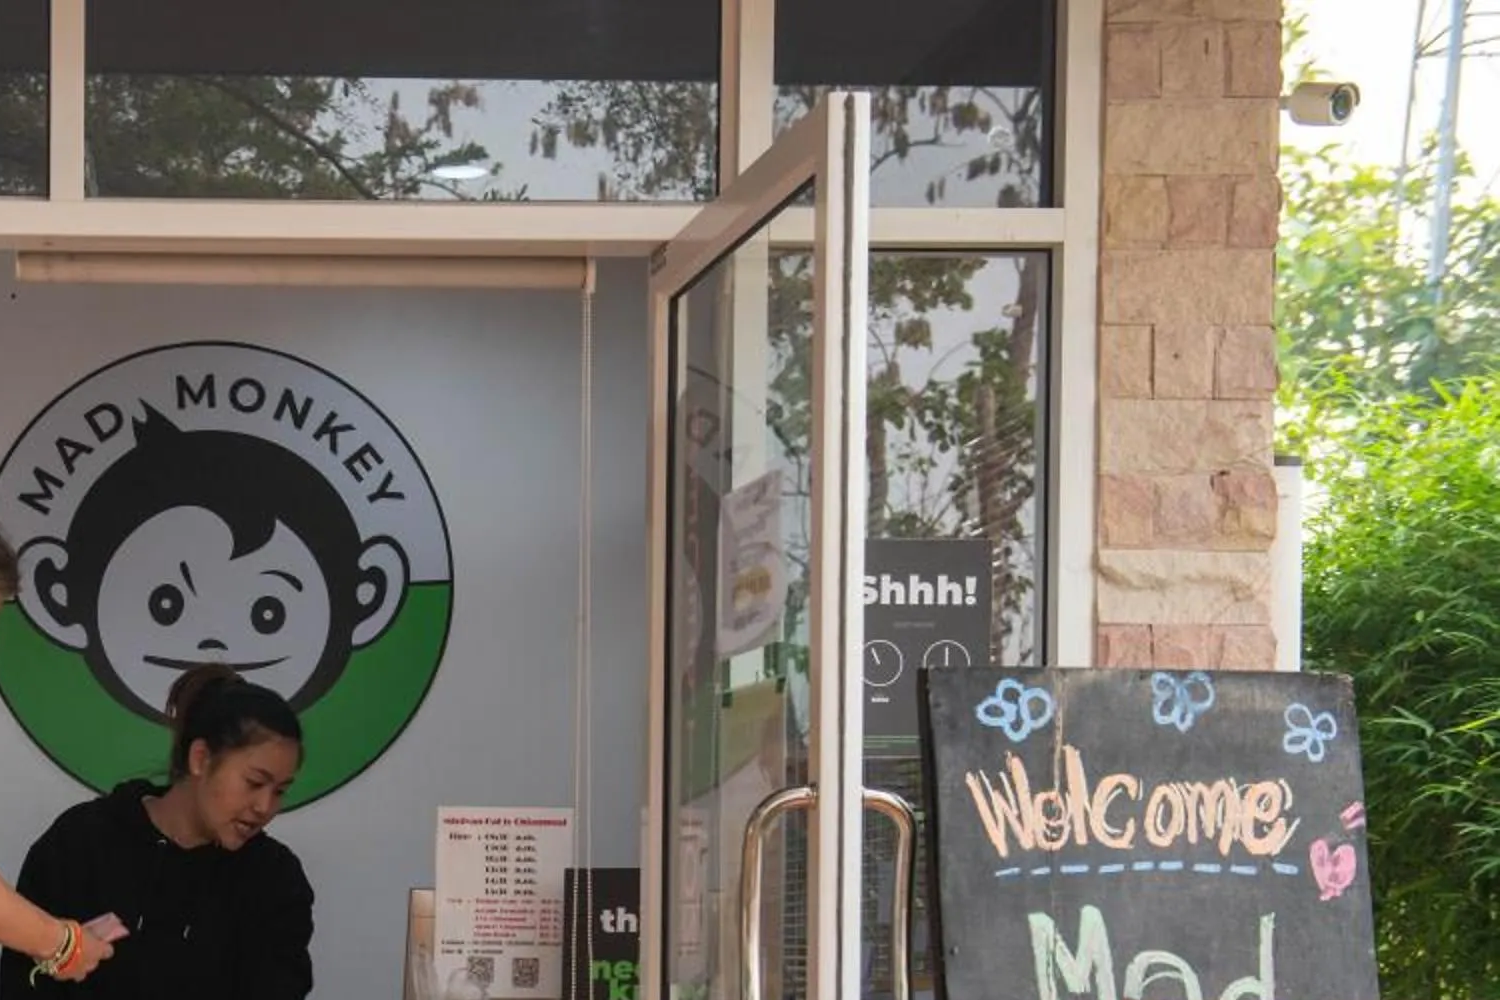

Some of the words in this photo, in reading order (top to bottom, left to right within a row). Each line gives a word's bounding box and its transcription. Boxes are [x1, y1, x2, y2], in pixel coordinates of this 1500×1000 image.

[17, 402, 124, 516] MAD
[175, 373, 406, 505] MONKEY
[965, 743, 1300, 858] Welcome
[600, 906, 638, 933] th
[591, 959, 640, 980] ne
